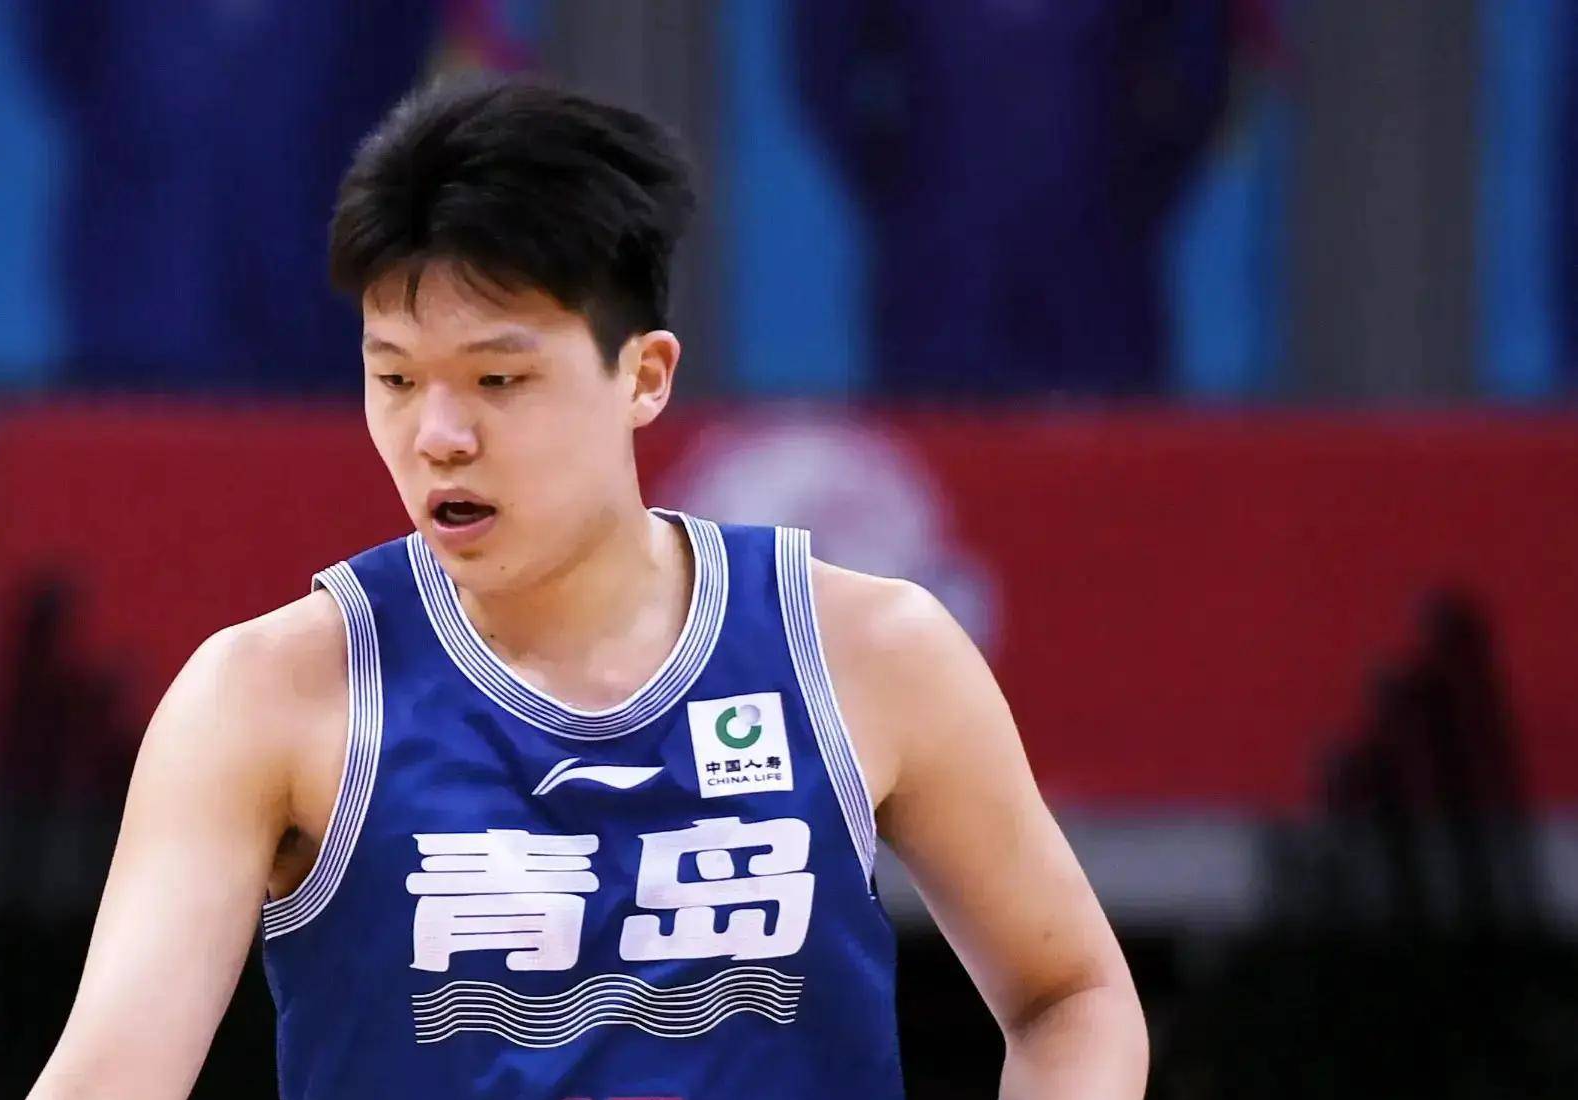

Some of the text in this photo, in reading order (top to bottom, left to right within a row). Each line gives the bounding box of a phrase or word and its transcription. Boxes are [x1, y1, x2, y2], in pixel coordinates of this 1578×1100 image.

[705, 756, 782, 775] 中国人寿
[707, 772, 782, 787] CHINA LIFE
[406, 816, 815, 972] 青岛
